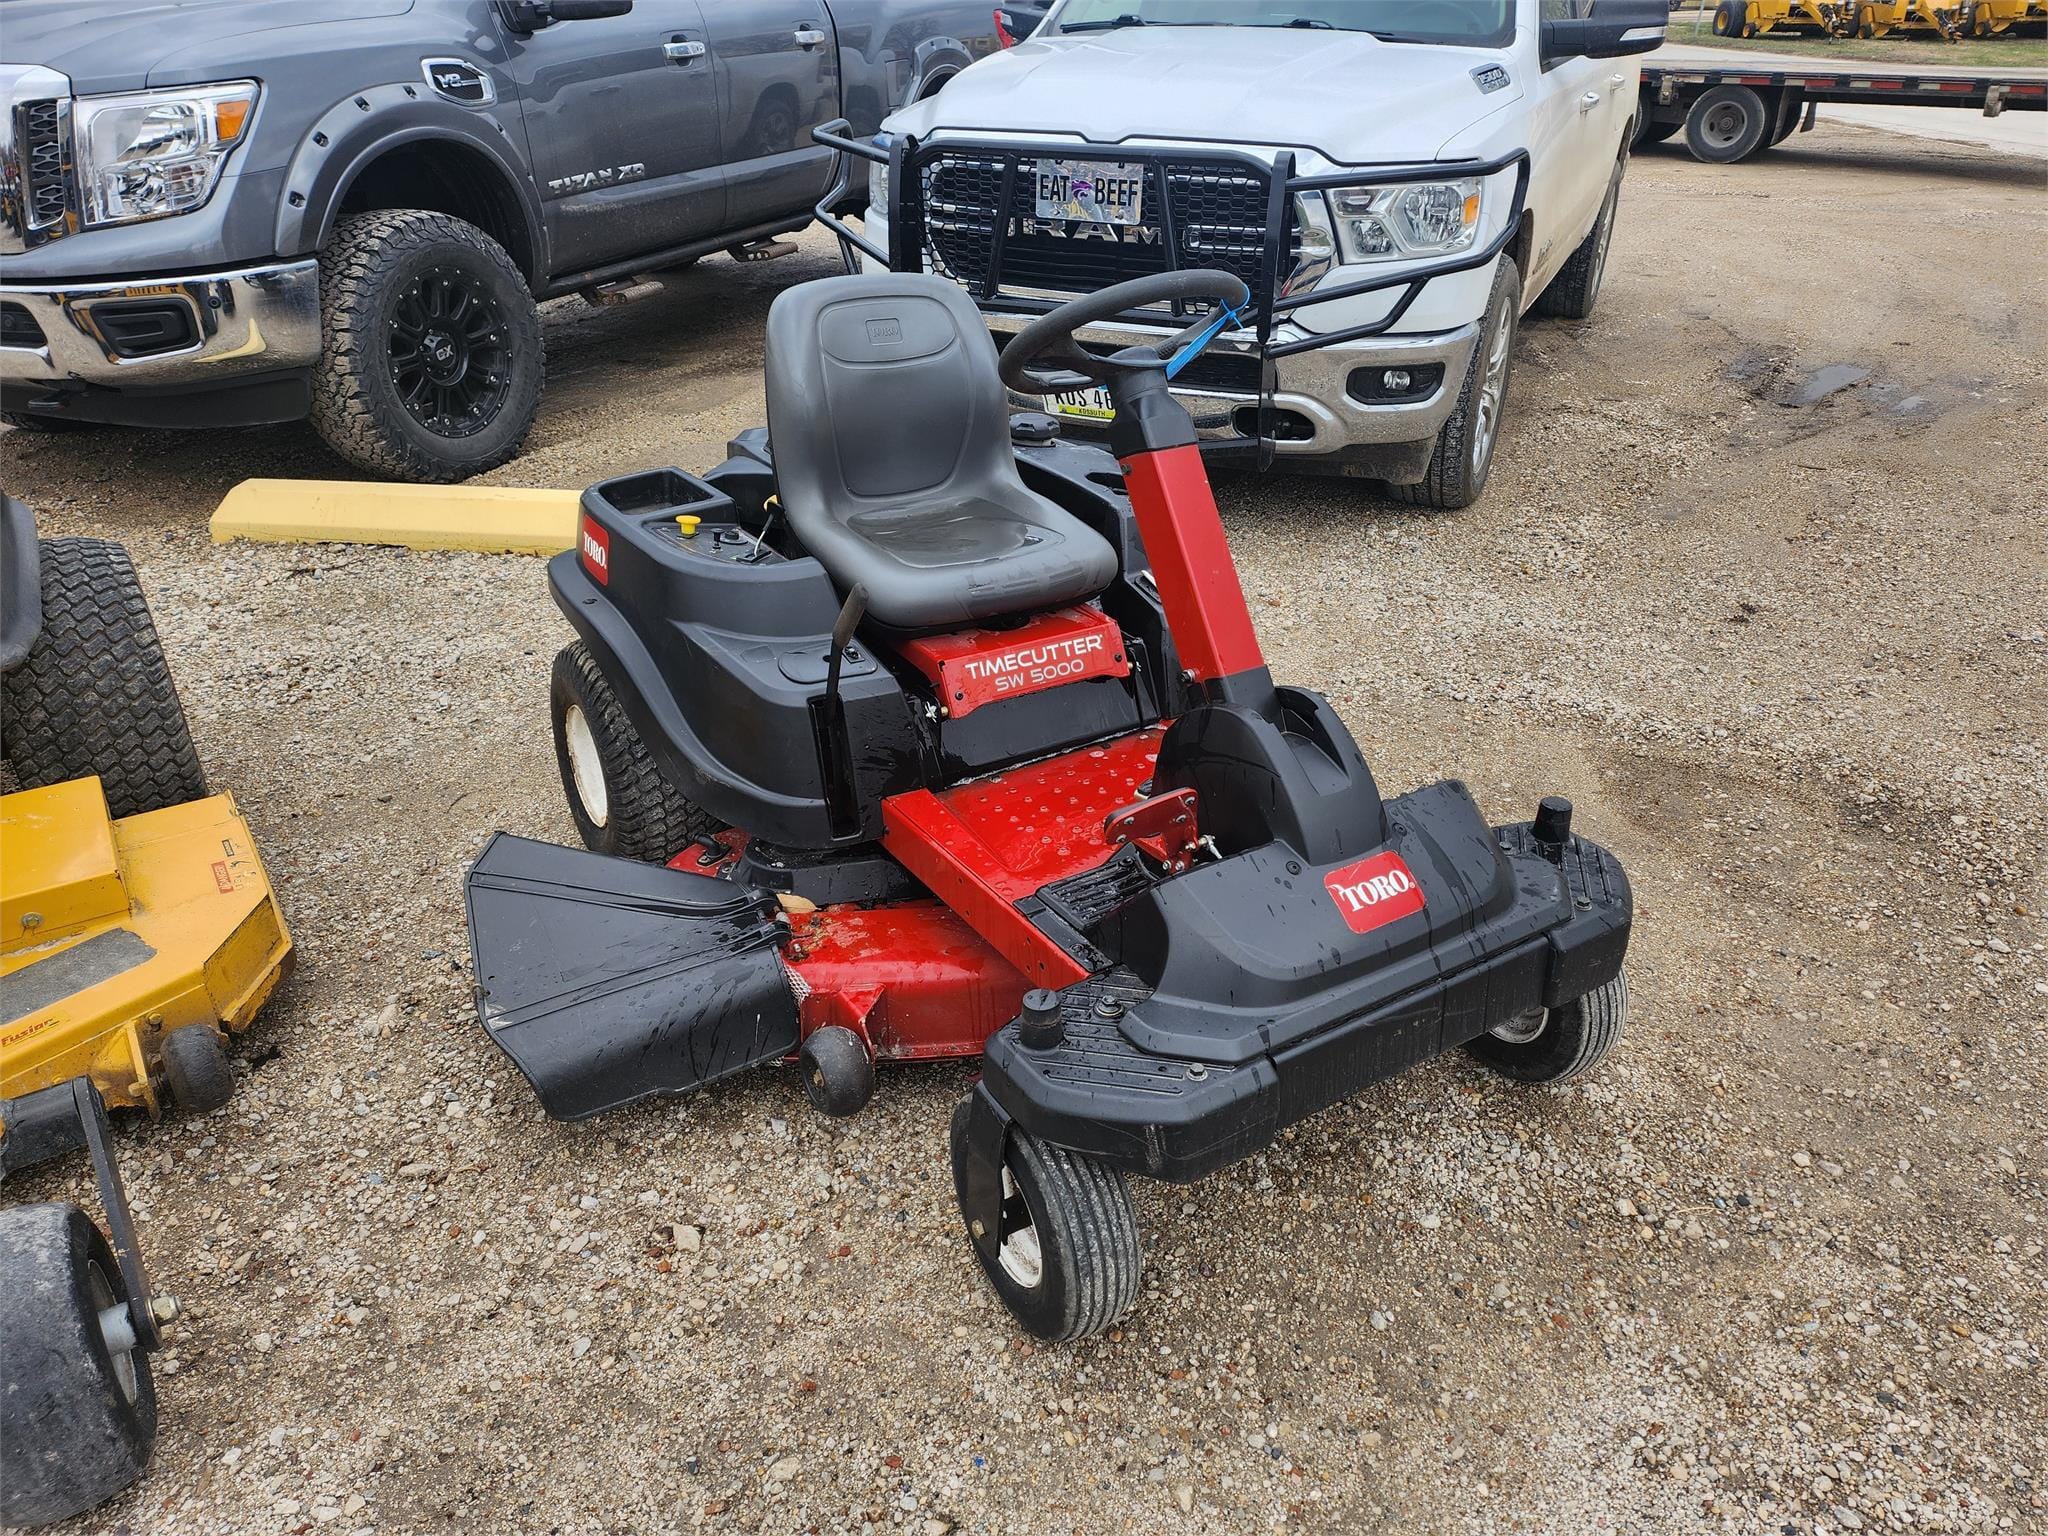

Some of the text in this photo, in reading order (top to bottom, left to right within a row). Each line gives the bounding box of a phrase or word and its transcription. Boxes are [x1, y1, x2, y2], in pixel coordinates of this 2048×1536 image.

[433, 73, 461, 88] V8
[548, 168, 613, 193] TITAN
[1039, 174, 1139, 207] EAT BEEF
[1022, 217, 1163, 246] RAM
[1079, 407, 1106, 417] KOSSUTH
[584, 530, 606, 568] TORO
[965, 633, 1103, 680] TIMECUTTER
[995, 659, 1085, 692] SW 5000
[1327, 869, 1410, 912] TORO
